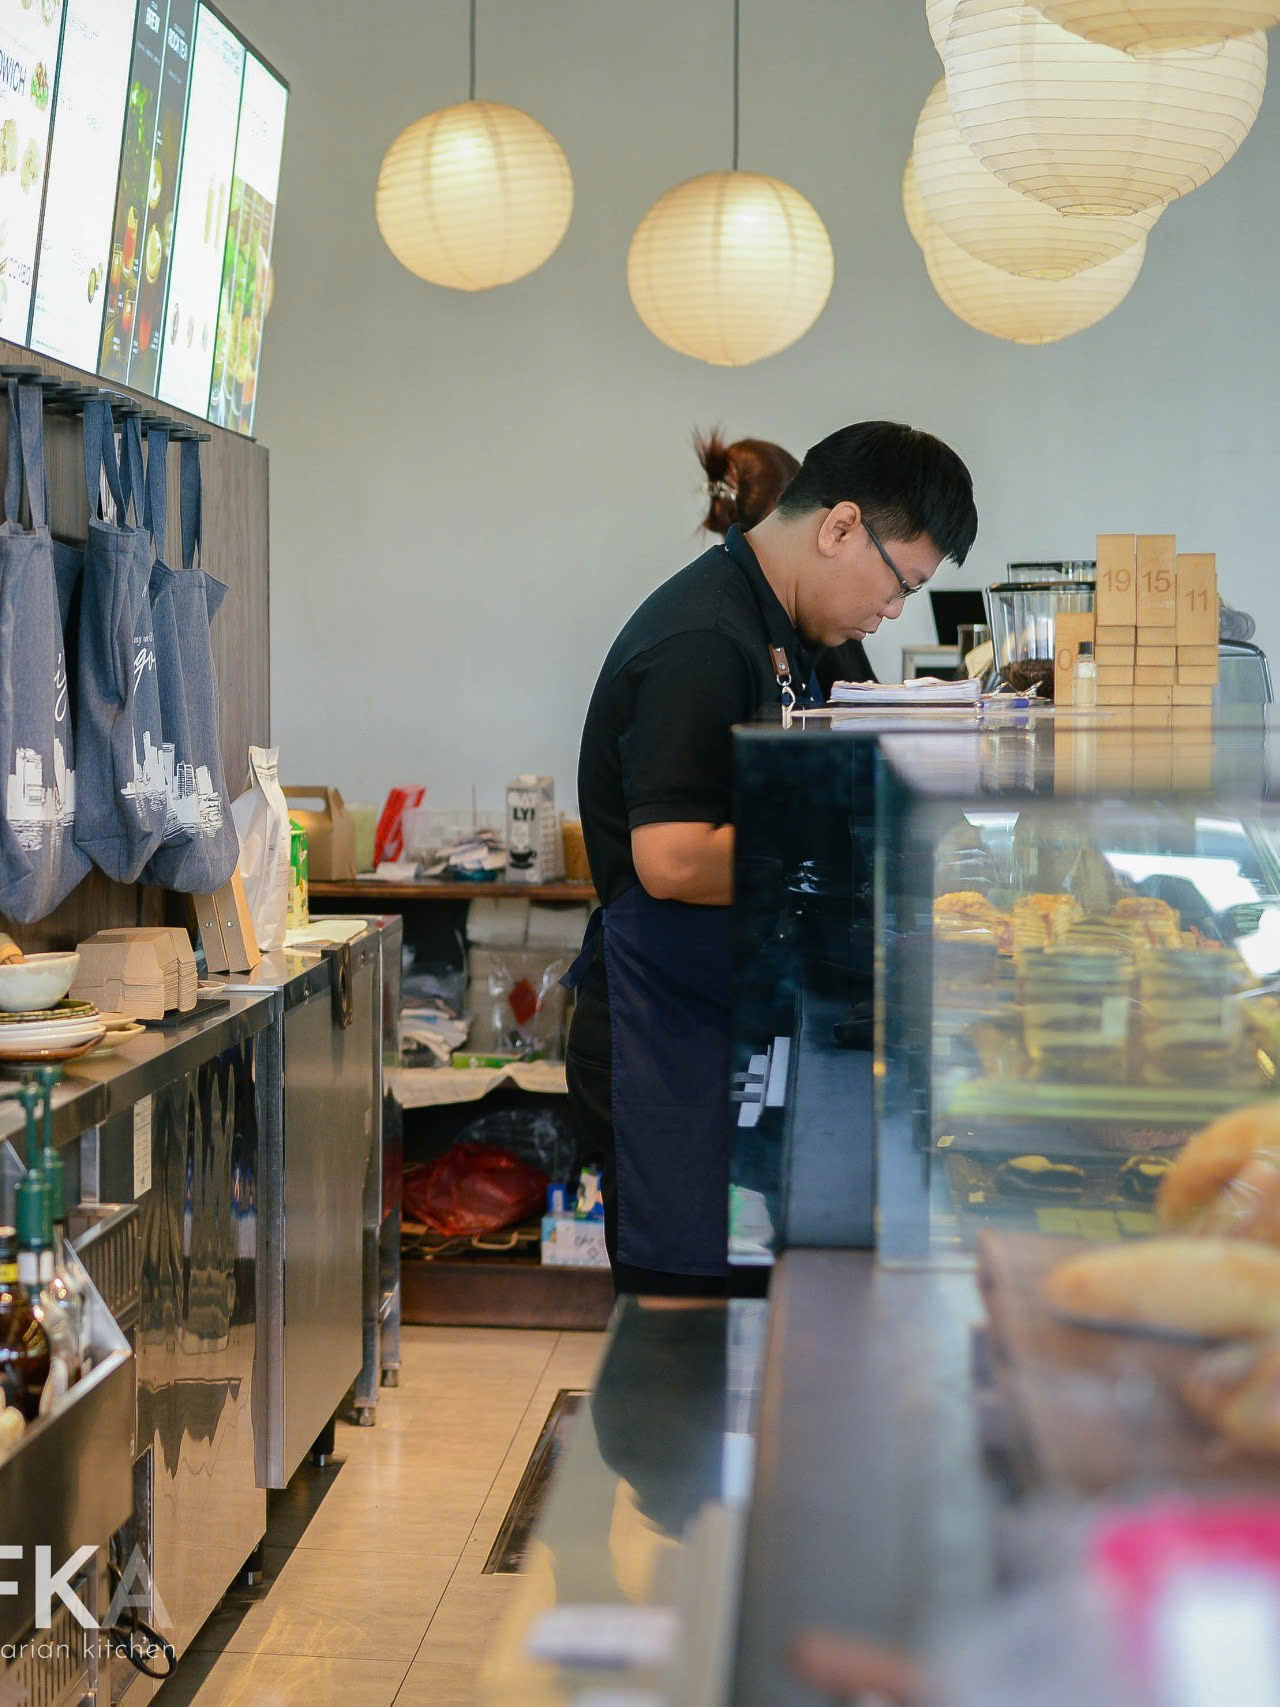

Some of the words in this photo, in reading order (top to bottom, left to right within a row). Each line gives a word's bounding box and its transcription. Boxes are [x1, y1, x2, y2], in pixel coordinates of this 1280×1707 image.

[1103, 569, 1131, 593] 19
[1141, 569, 1171, 593] 15
[1185, 588, 1208, 612] 11
[1057, 648, 1073, 671] 0
